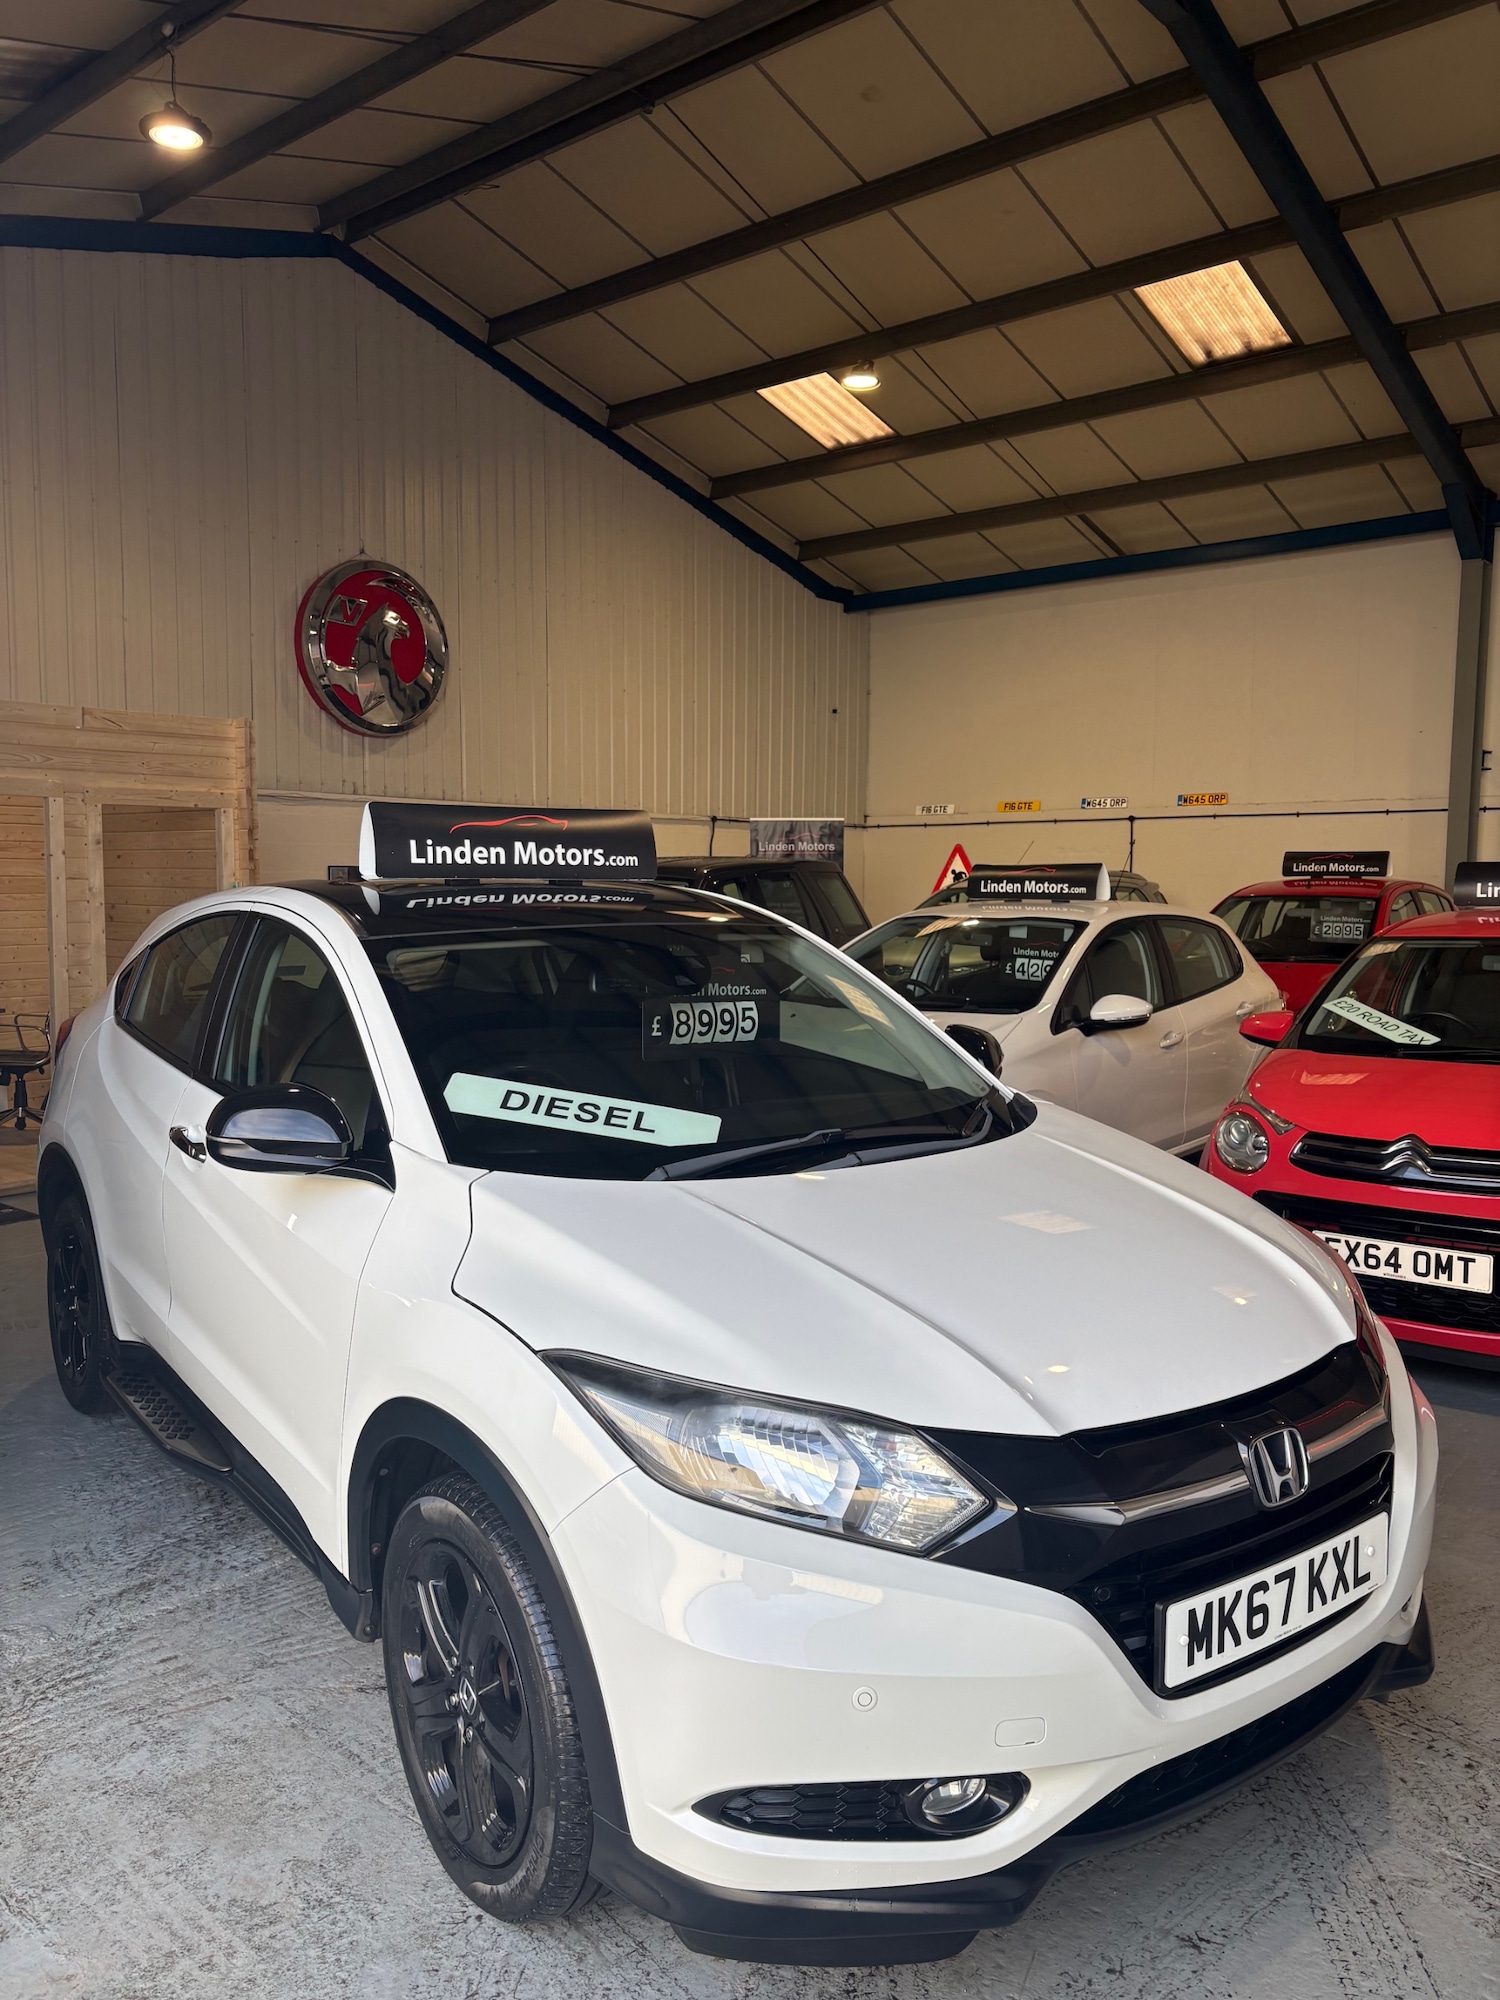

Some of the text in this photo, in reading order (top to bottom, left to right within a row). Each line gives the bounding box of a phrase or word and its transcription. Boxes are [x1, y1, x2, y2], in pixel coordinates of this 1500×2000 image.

[1086, 798, 1126, 807] W645 ORP
[1183, 794, 1226, 804] W645 ORP
[934, 805, 948, 813] GTE
[1004, 801, 1033, 810] F16 GTE
[759, 842, 835, 851] Linden Motors
[409, 839, 639, 867] Linden Motors.com
[1293, 863, 1380, 873] Linden Motors.com
[980, 880, 1087, 894] Linden Motors.com
[1324, 924, 1363, 936] 2995
[1013, 946, 1040, 957] Linden
[708, 983, 767, 996] Motors.com
[675, 1007, 756, 1038] 8995
[1332, 1000, 1431, 1045] £20 ROAD TAX
[499, 1089, 656, 1134] DIESEL
[1413, 1250, 1476, 1284] OMT
[1187, 1535, 1371, 1668] MK67 KXL
